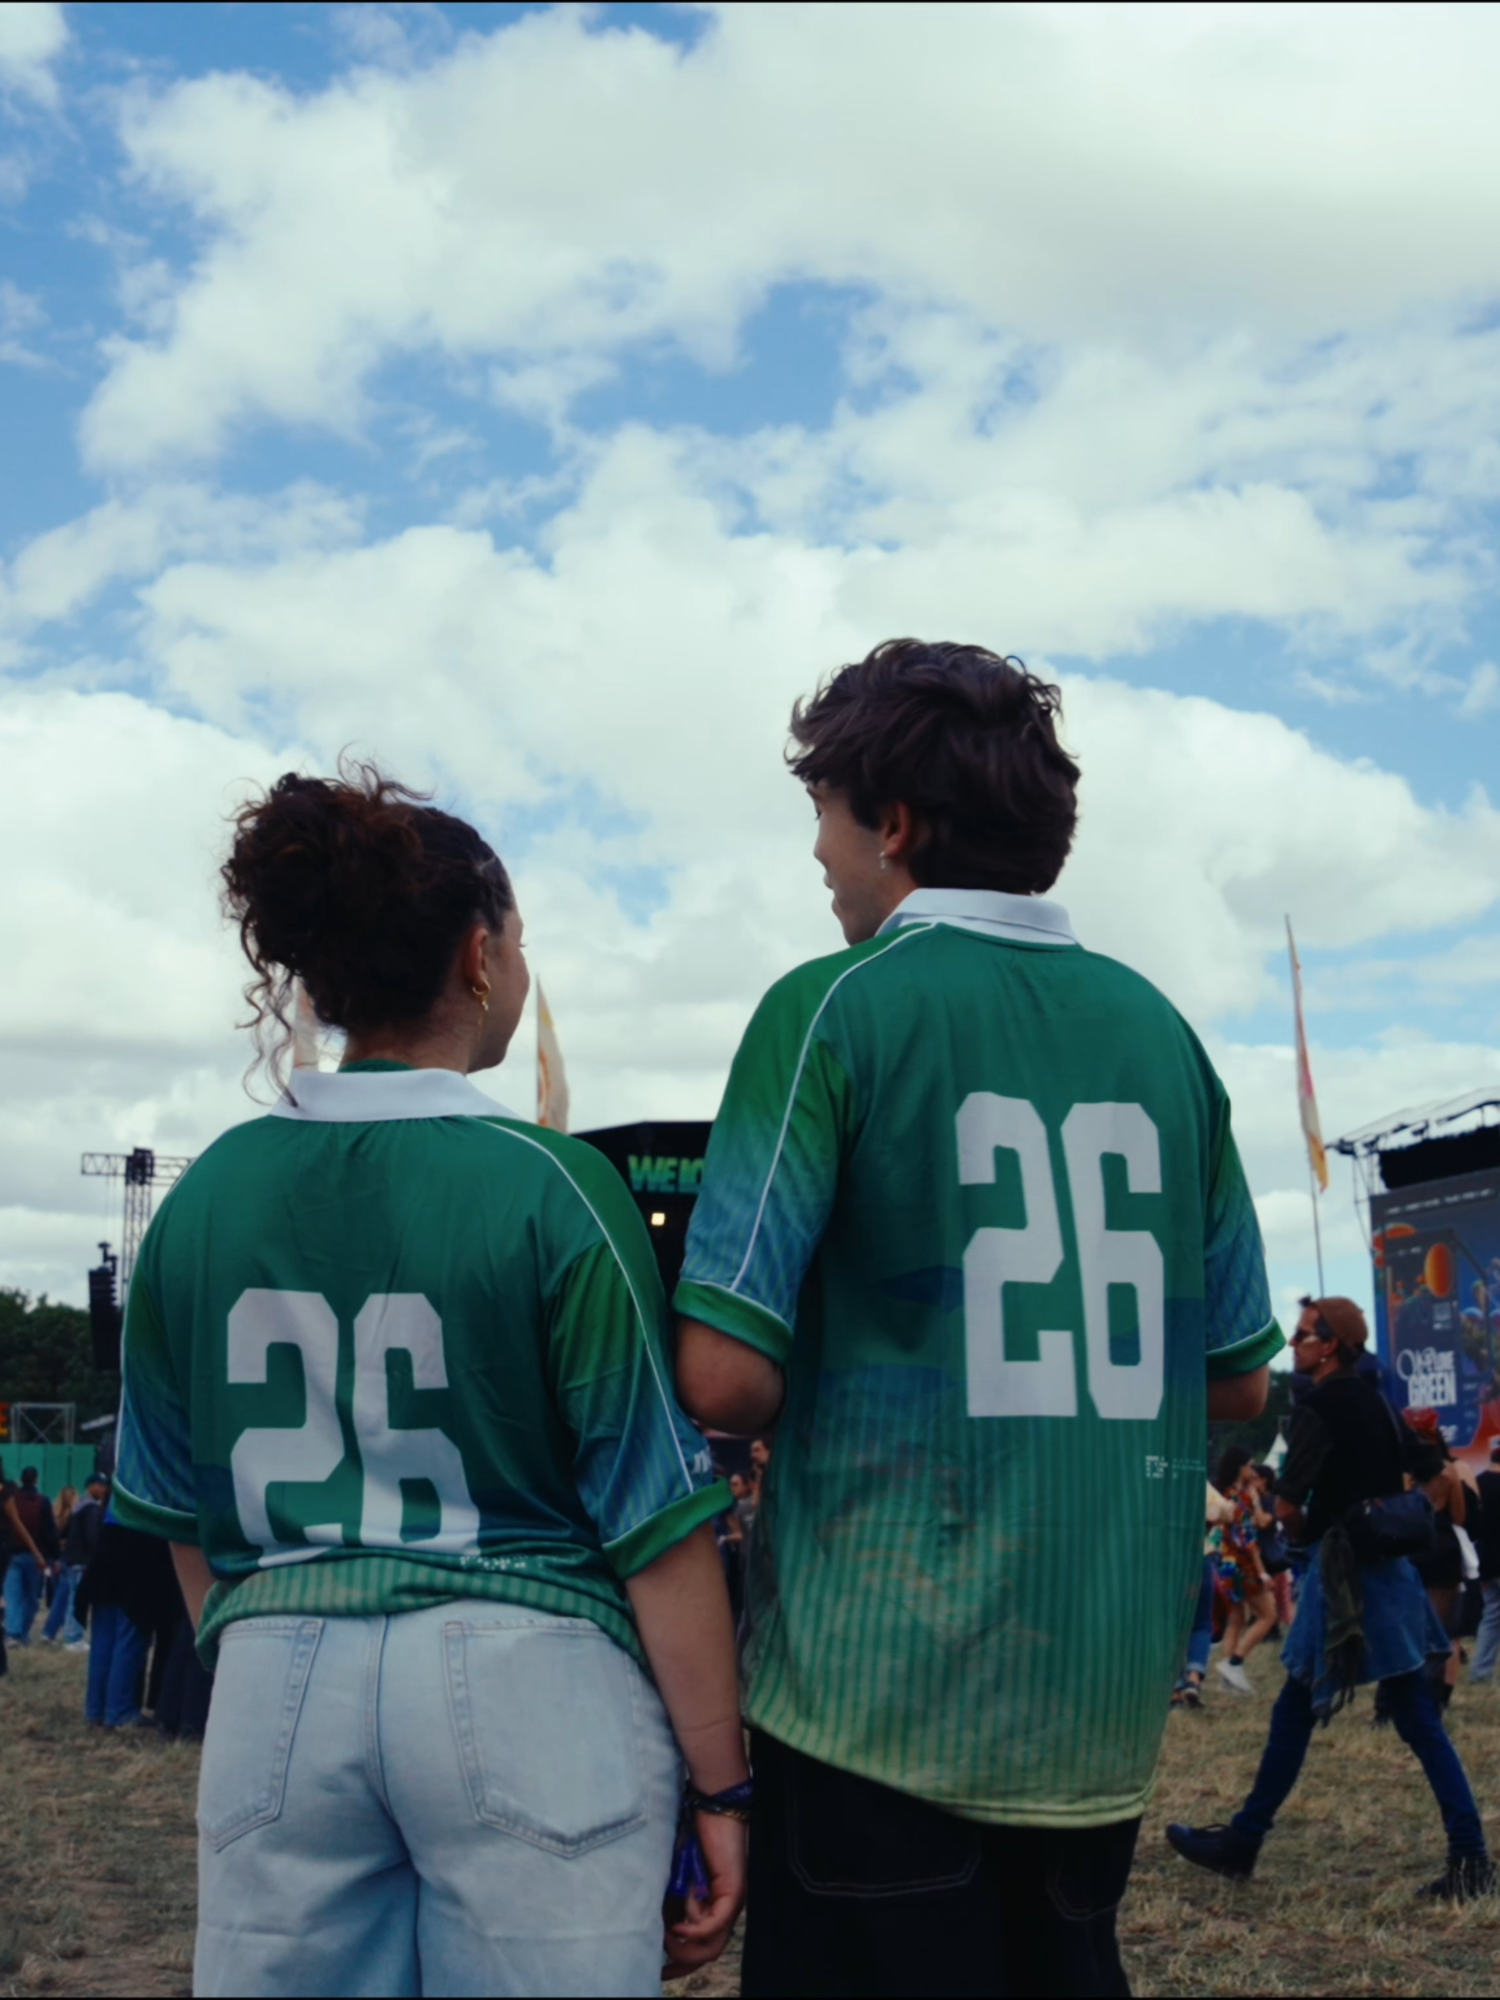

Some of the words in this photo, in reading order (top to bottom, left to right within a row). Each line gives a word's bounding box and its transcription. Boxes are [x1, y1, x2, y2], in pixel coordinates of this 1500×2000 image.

[955, 1091, 1164, 1420] 26
[1408, 1371, 1457, 1408] GREEN
[227, 1287, 481, 1567] 26
